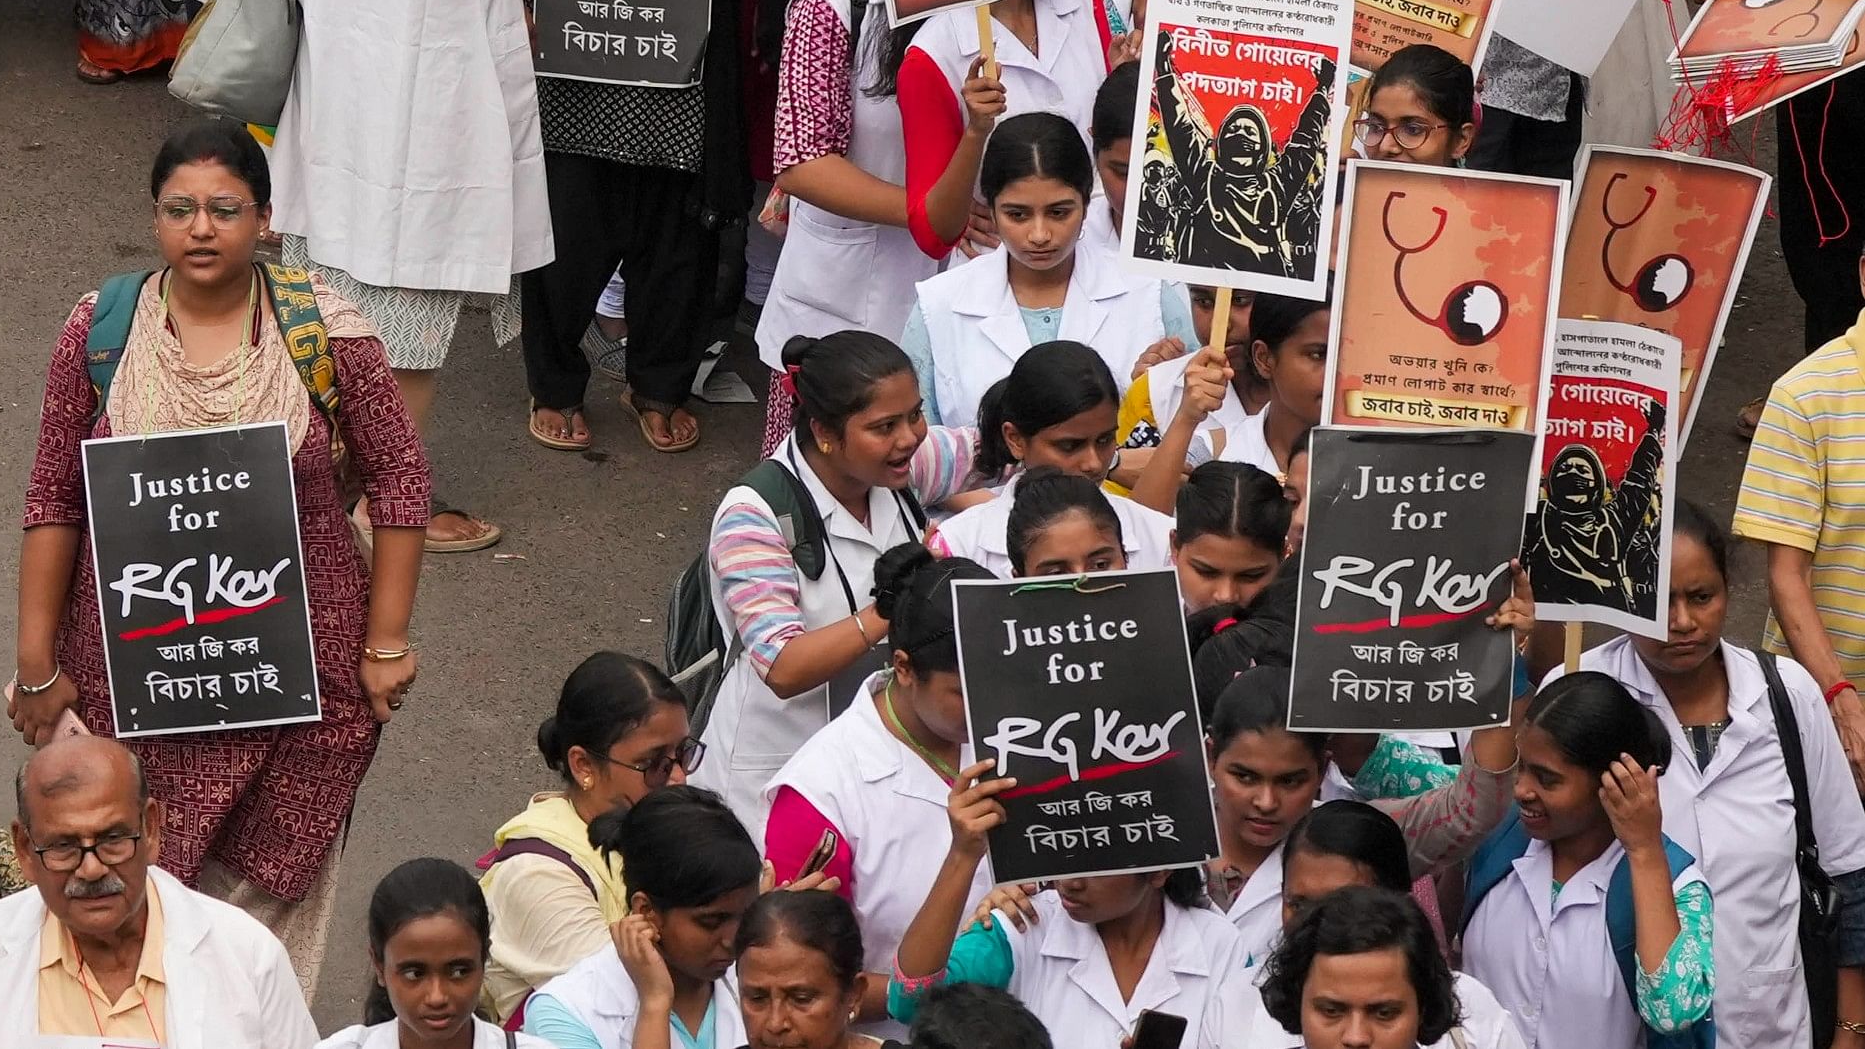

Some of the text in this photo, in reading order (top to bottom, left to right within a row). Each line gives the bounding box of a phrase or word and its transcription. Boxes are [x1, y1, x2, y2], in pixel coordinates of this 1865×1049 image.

[576, 0, 610, 19] আর
[636, 6, 665, 23] কর
[1196, 15, 1305, 36] কলকাতা পুলিশের কমিশনার
[561, 21, 678, 61] বিচার চাই
[1170, 27, 1325, 74] বিনীত গোয়েলের
[1180, 70, 1303, 105] পদত্যাগ চাই।
[1361, 397, 1405, 415] জবাব
[1407, 398, 1435, 419] চাই,
[1438, 405, 1479, 423] জবাব
[1562, 382, 1654, 416] গোয়েলের
[1591, 416, 1634, 444] চাই।
[129, 467, 251, 507] Justice
[1352, 463, 1485, 500] Justice
[167, 503, 220, 532] for
[1390, 501, 1449, 532] for
[109, 553, 291, 625] RG Kar
[1313, 554, 1510, 627] RG Kar
[156, 635, 259, 662] আর জি কর
[1001, 614, 1138, 656] Justice
[1350, 640, 1460, 665] আর জি কর
[143, 661, 284, 704] বিচার চাই
[1045, 652, 1105, 686] for
[1329, 668, 1477, 705] বিচার চাই
[982, 706, 1187, 782] RG Kar
[1038, 790, 1152, 817] আর জি কর
[1024, 812, 1178, 854] বিচার চাই
